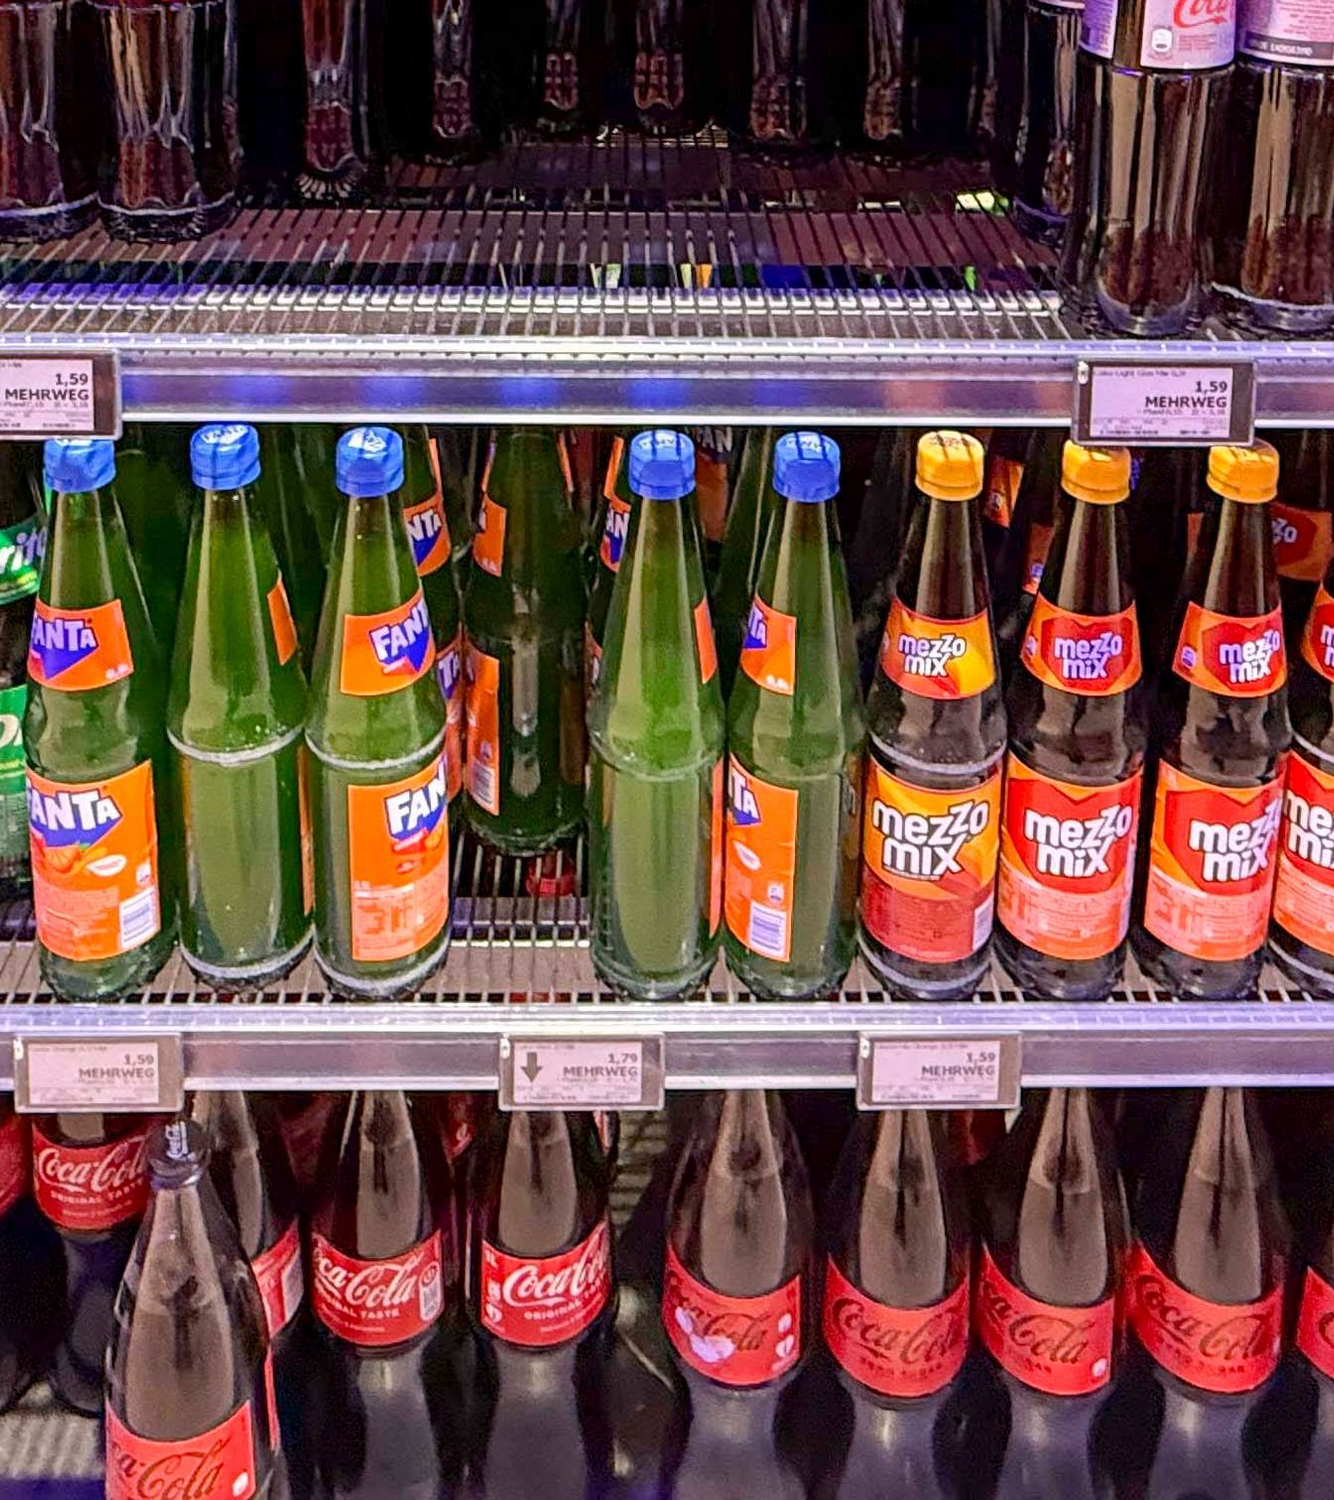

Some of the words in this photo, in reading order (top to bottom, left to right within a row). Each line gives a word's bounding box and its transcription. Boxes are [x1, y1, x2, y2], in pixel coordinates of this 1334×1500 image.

[55, 372, 89, 388] 1,59
[1194, 380, 1228, 394] 1,59
[4, 388, 90, 401] MEHRWEG
[1144, 395, 1228, 409] MEHRWEG
[897, 633, 966, 658] mezzo
[1053, 630, 1123, 661] mezzo
[1219, 629, 1281, 667] mezzo
[904, 651, 949, 677] mix
[1062, 650, 1109, 680] mix
[1229, 648, 1274, 684] mix
[872, 799, 990, 839] mezzo
[1024, 804, 1132, 849] mezzo
[882, 835, 965, 877] mix
[1036, 837, 1111, 879] mix
[1203, 835, 1270, 883] mix
[921, 1064, 996, 1077] MEHRWEG
[966, 1051, 996, 1064] 1,59
[78, 1067, 155, 1079] MEHRWEG
[562, 1066, 639, 1078] MEHRWEG
[37, 1136, 148, 1194] Coca-Col
